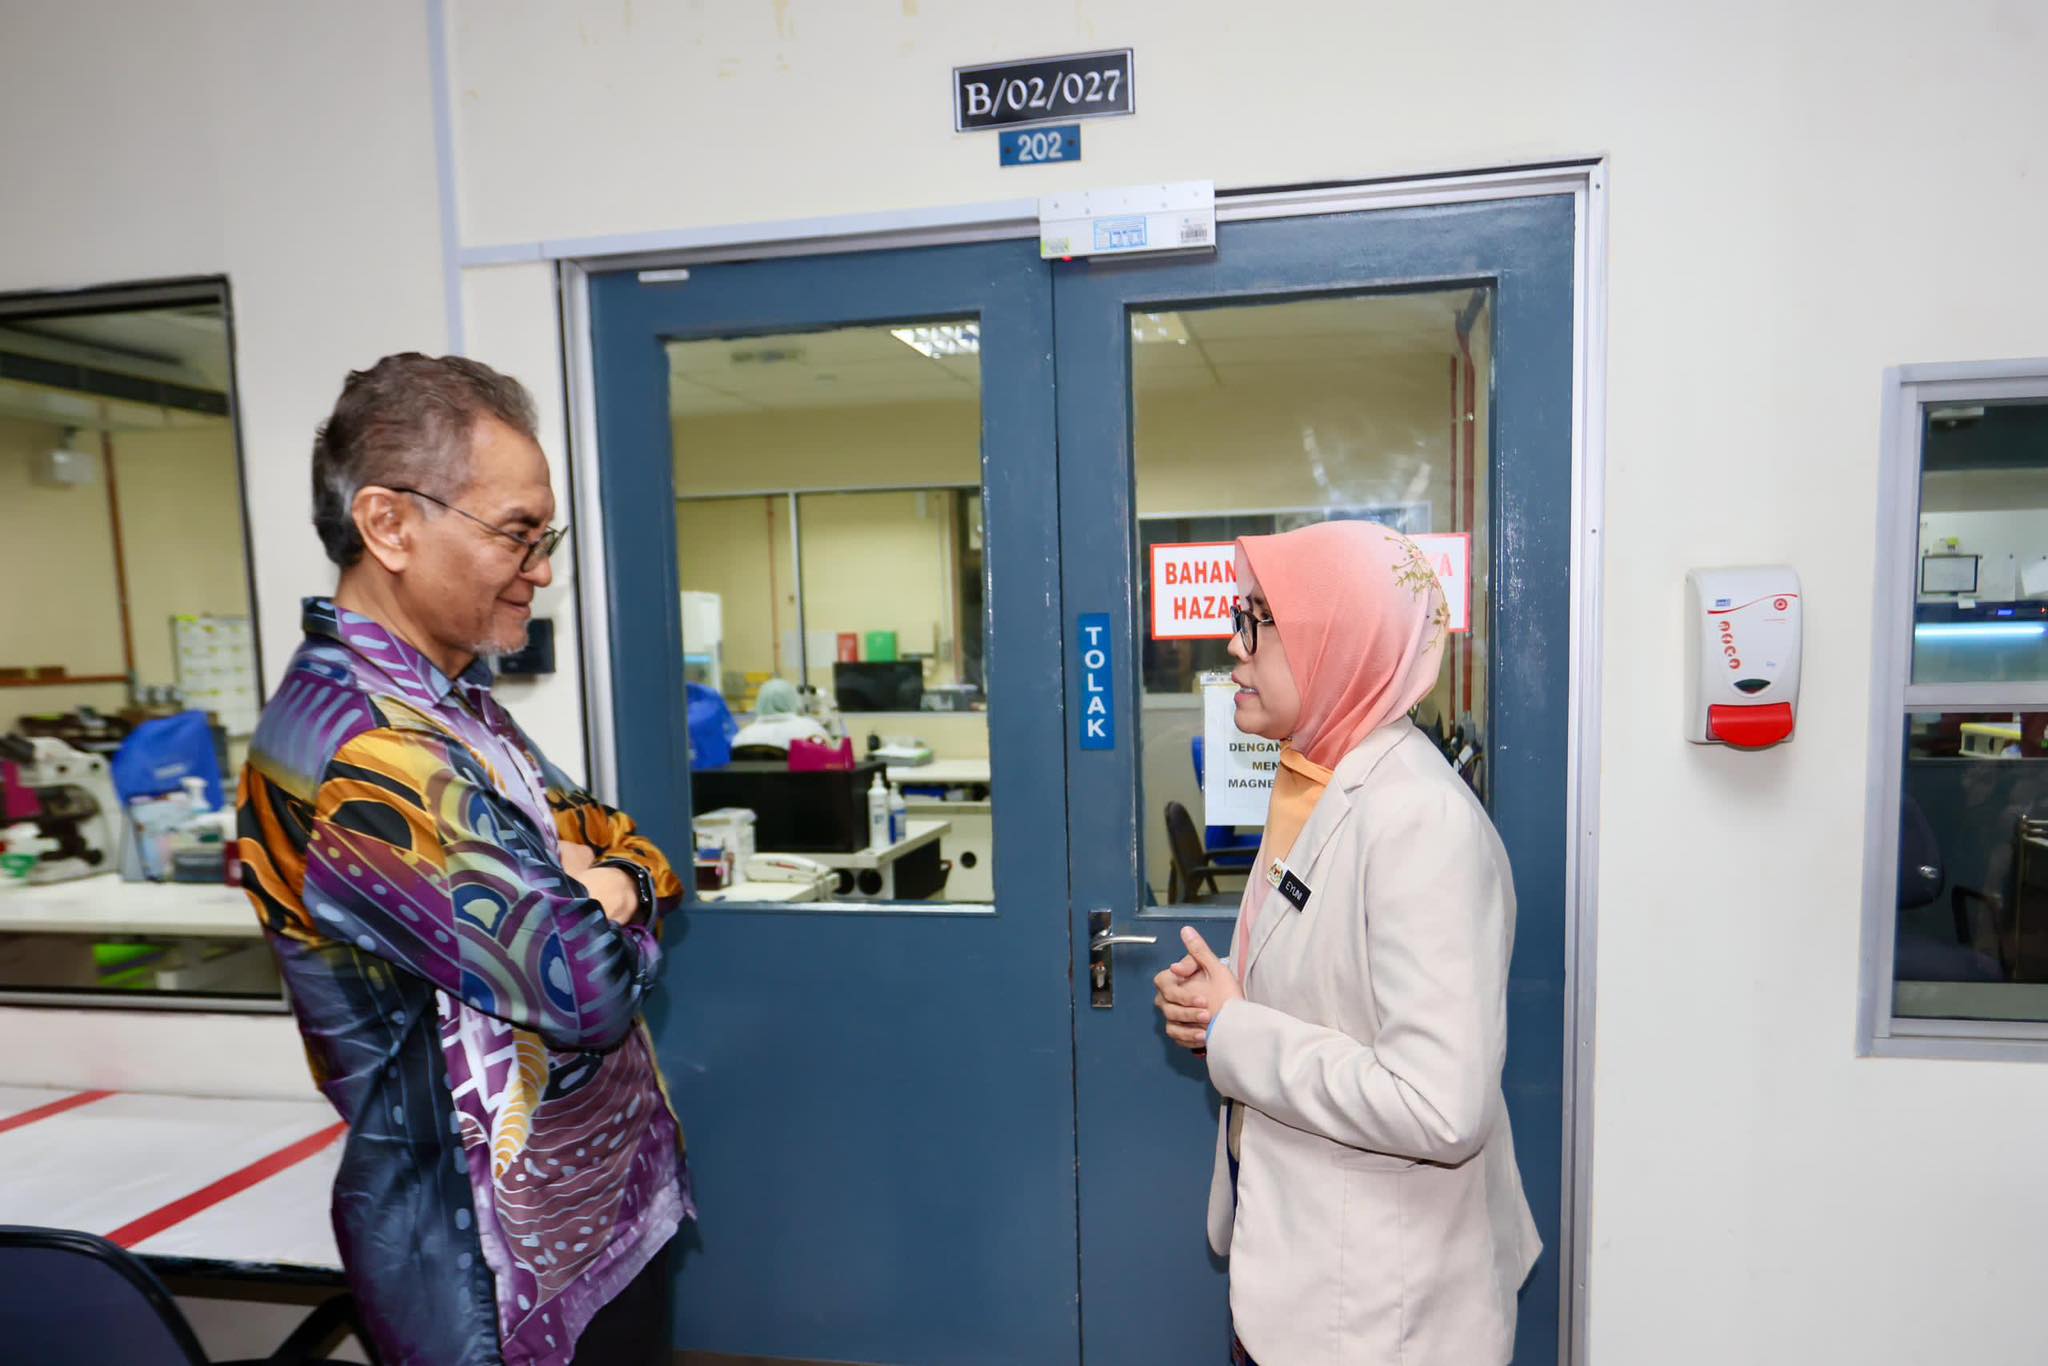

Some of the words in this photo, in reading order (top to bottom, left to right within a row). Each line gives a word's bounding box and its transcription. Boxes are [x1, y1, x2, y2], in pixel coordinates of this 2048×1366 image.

[965, 70, 1121, 117] B/02/027
[1018, 132, 1063, 161] 202
[1165, 560, 1237, 585] BAHAN
[1084, 626, 1106, 737] TOLAK
[1228, 741, 1281, 752] DENGAN
